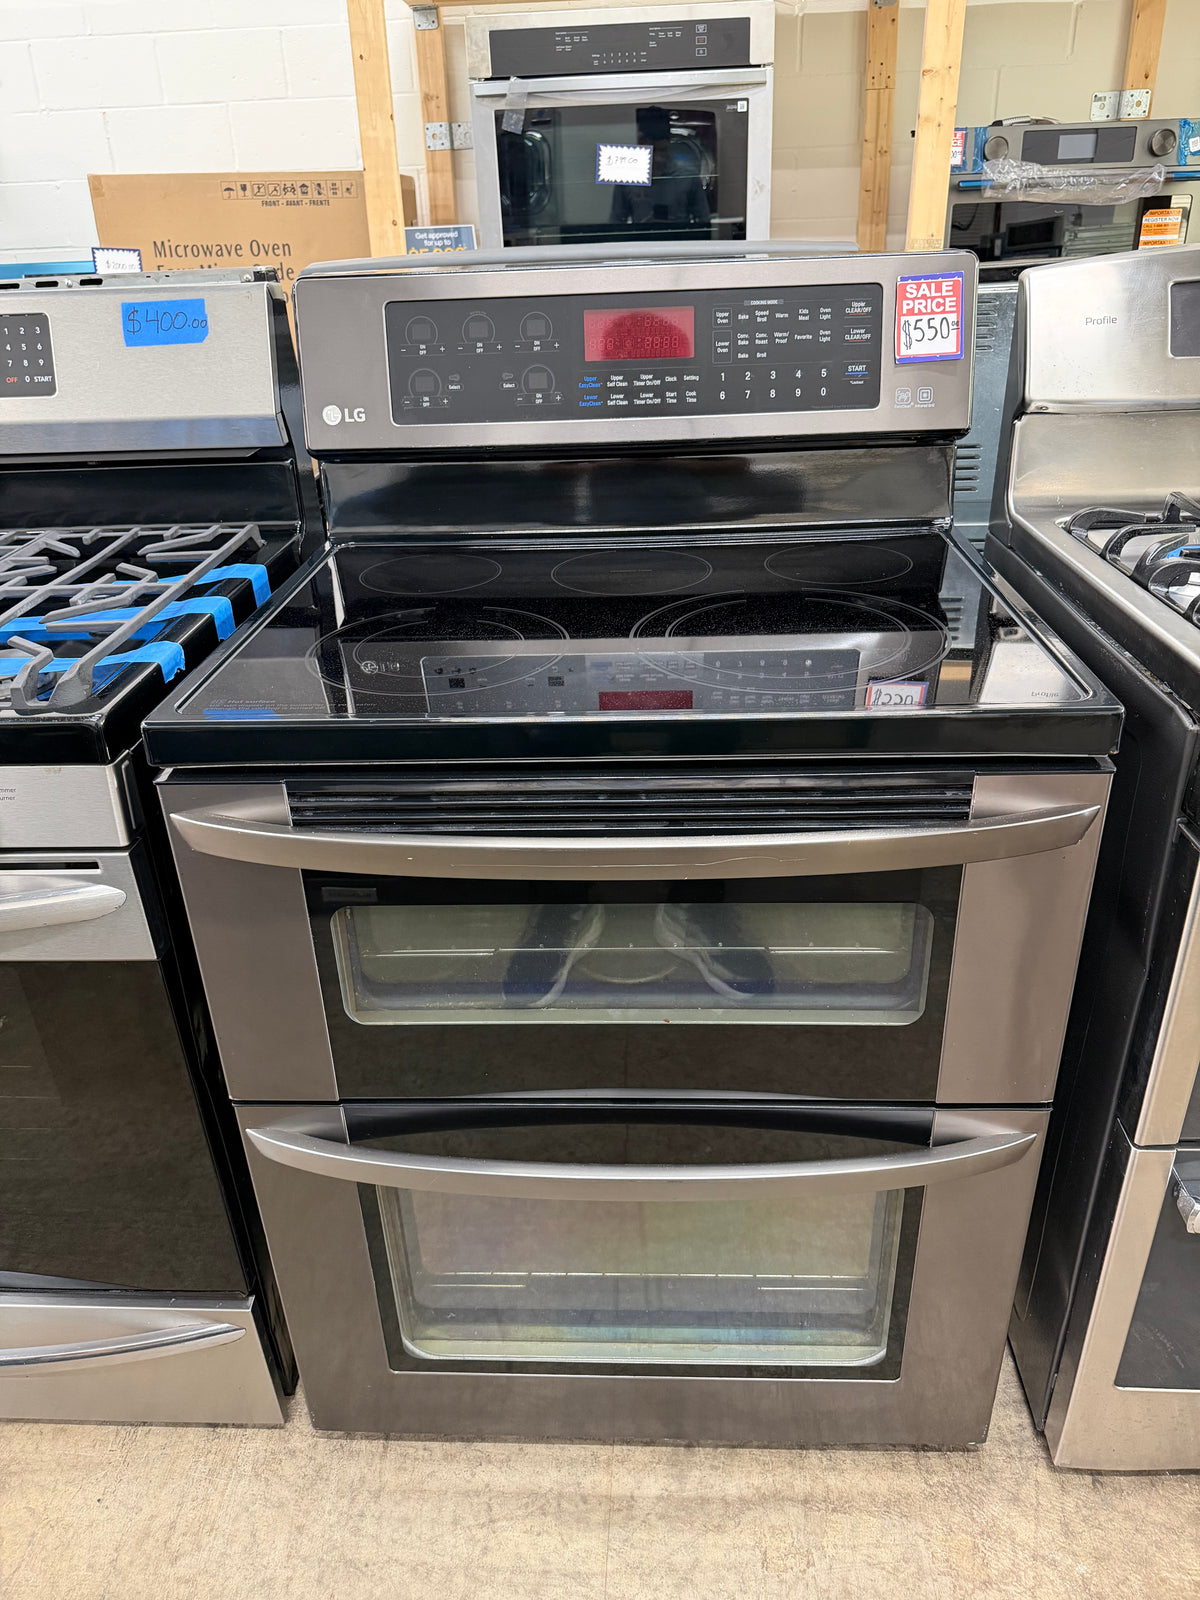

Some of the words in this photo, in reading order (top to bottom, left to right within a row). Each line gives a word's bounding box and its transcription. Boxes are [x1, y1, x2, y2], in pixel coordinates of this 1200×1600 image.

[428, 231, 458, 240] approved
[153, 239, 243, 258] Microwave
[250, 240, 292, 257] Oven
[906, 281, 953, 298] SALE
[902, 297, 957, 314] PRICE
[126, 306, 207, 335] $400.00
[1086, 316, 1118, 325] Profile
[720, 373, 725, 381] 1
[745, 372, 751, 381] 2
[770, 371, 776, 380] 3
[795, 370, 801, 378] 4
[821, 369, 826, 377] 5
[720, 391, 725, 400] 6
[745, 390, 751, 399] 7
[770, 389, 776, 398] 8
[795, 388, 801, 397] 9
[821, 387, 826, 396] 0
[344, 408, 366, 422] LG
